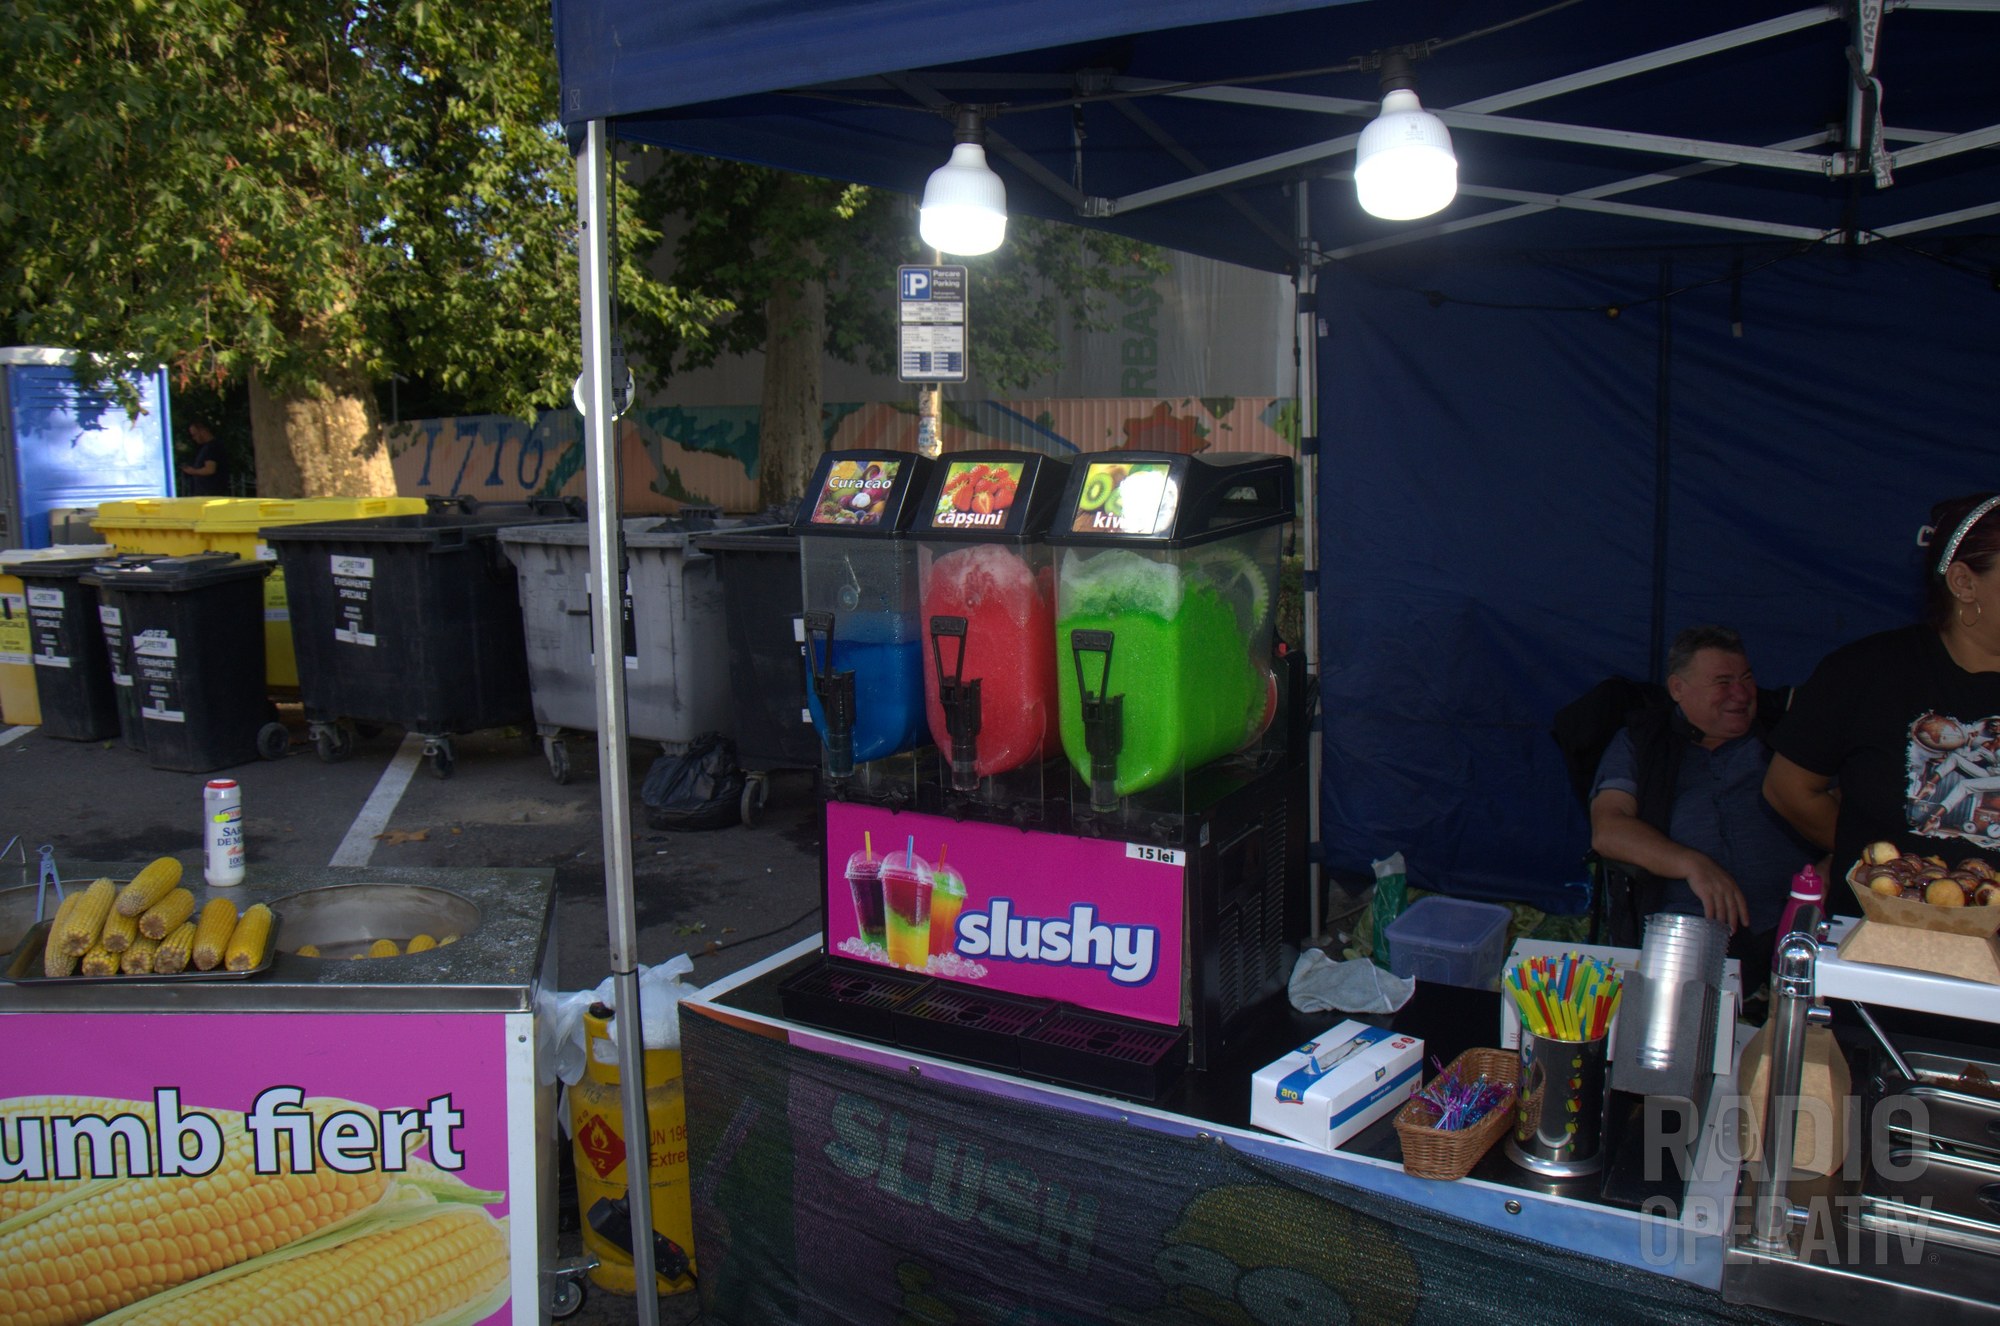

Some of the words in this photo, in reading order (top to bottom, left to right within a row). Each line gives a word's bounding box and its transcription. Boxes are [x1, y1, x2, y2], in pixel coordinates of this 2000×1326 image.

[1863, 0, 1878, 53] MAS
[909, 273, 928, 296] P
[933, 280, 960, 288] Parking
[829, 477, 892, 489] Curacao
[937, 510, 1003, 528] căpșuni
[933, 620, 960, 633] PULL
[1075, 632, 1107, 646] PULL
[1138, 847, 1154, 859] 15
[1157, 849, 1174, 863] lei
[956, 899, 1157, 985] slushy
[1281, 1087, 1298, 1100] aro
[0, 1087, 225, 1184] umb
[245, 1085, 465, 1175] fiert
[824, 1093, 1100, 1273] SLUSH
